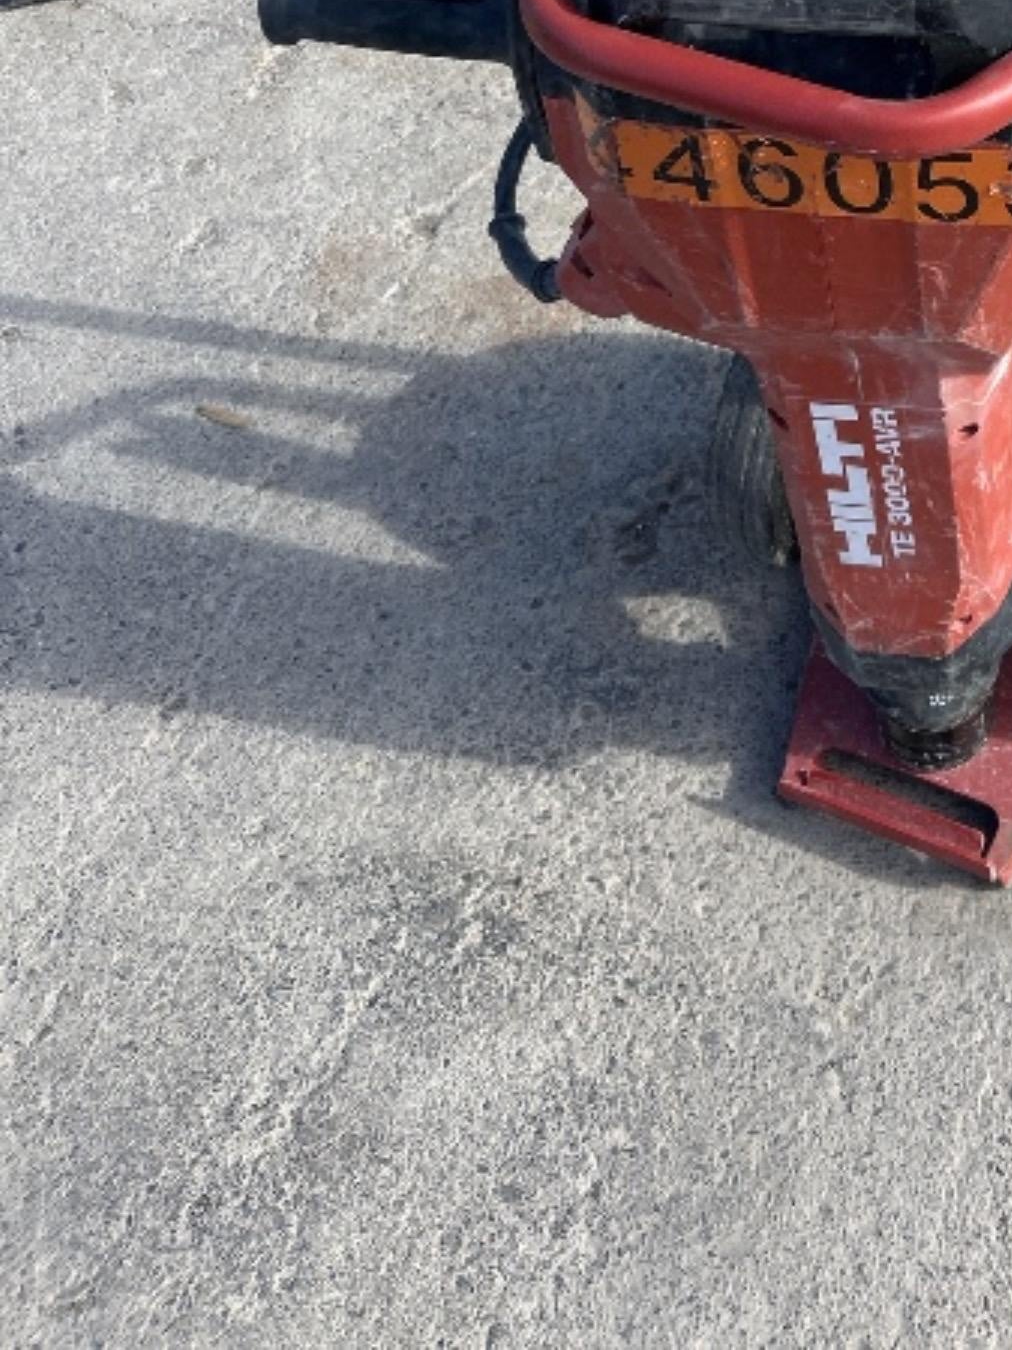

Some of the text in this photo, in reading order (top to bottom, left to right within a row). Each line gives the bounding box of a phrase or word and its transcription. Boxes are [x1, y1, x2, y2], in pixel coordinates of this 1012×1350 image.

[809, 402, 883, 567] HILTI
[870, 407, 916, 558] TE 3000-AVR
